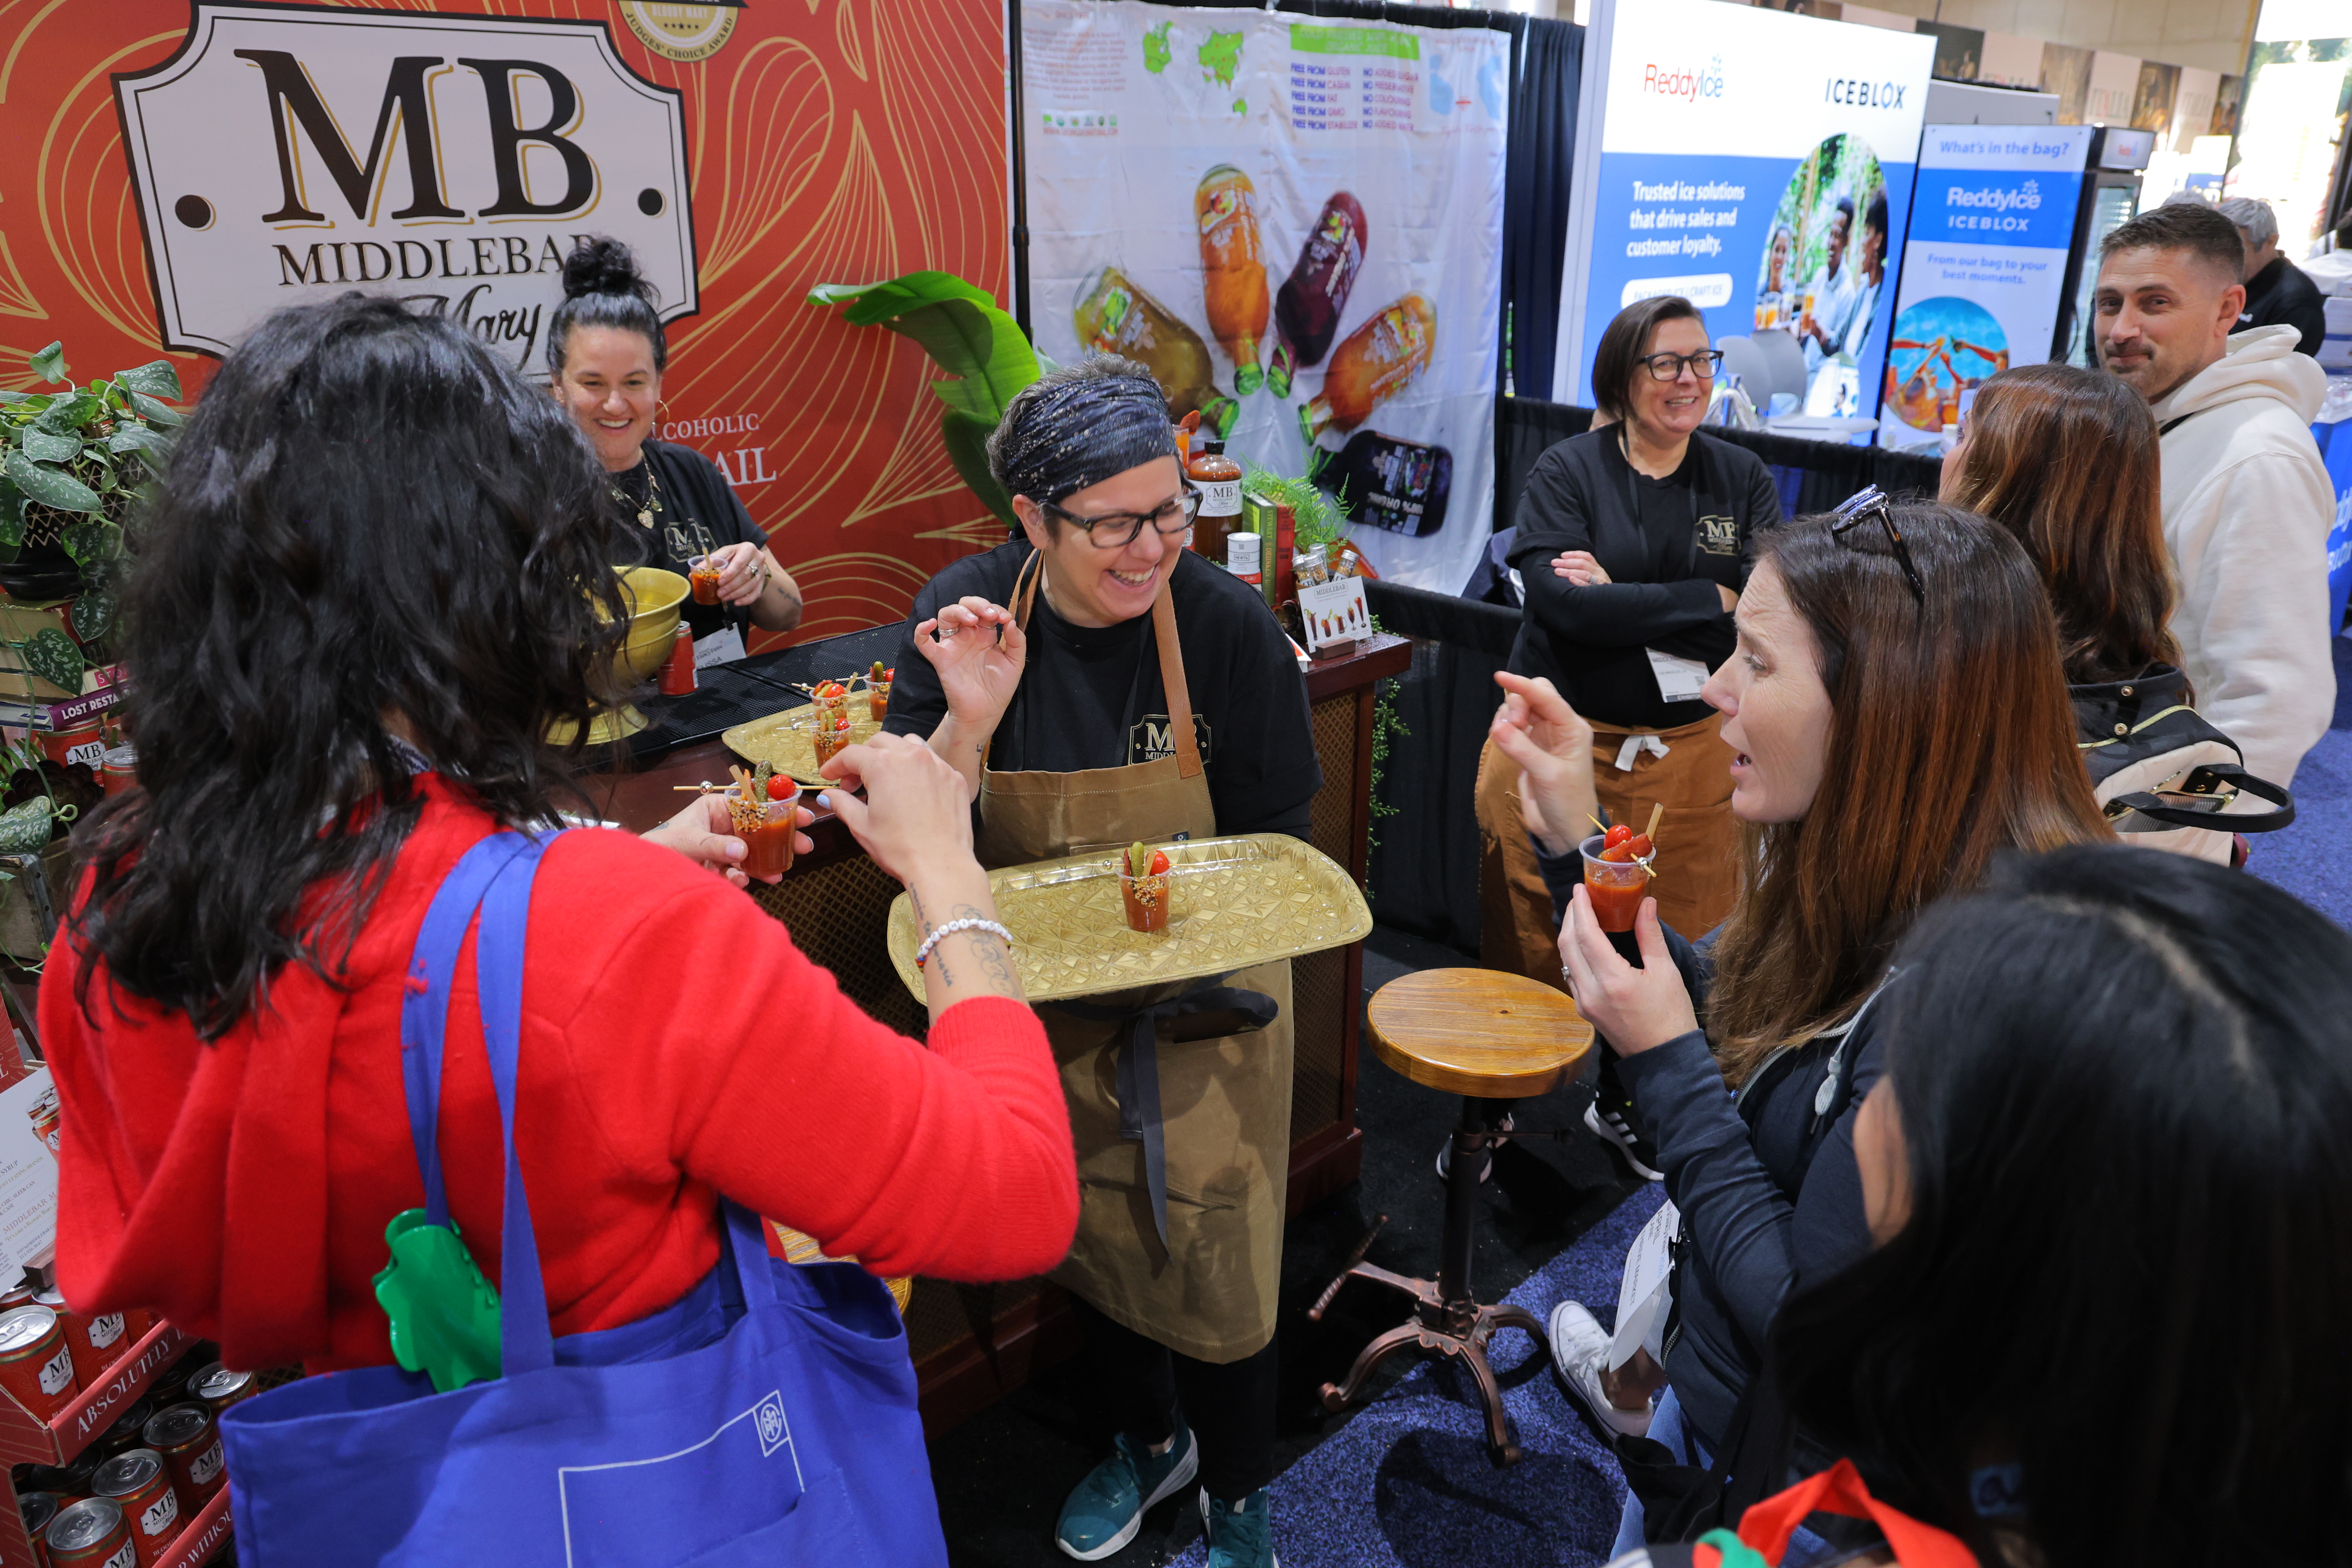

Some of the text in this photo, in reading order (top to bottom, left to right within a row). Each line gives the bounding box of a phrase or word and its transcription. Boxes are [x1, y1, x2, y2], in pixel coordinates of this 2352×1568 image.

[652, 4, 708, 19] BLOODY MARY
[667, 47, 706, 58] CHOICE
[708, 17, 732, 51] AWARD
[1291, 63, 1305, 73] FREE
[1307, 65, 1325, 75] FROM
[1363, 67, 1373, 76] NO
[1291, 77, 1305, 87] FREE
[1307, 79, 1325, 89] FROM
[1363, 81, 1372, 89] NO
[1644, 64, 1723, 102] ReddyIce
[1292, 90, 1305, 101] FREE
[1307, 92, 1326, 102] FROM
[1363, 95, 1373, 103] NO
[1825, 78, 1907, 109] ICEBLOX
[1292, 104, 1306, 114] FREE
[1308, 106, 1326, 116] FROM
[1363, 107, 1372, 116] NO
[1293, 118, 1306, 128] FREE
[1308, 120, 1326, 129] FROM
[1363, 120, 1372, 128] NO
[234, 48, 600, 227] MB
[1940, 140, 2069, 158] What's in the bag?
[1633, 180, 1746, 201] Trusted ice solutions
[1947, 186, 2042, 212] ReddyIce
[1630, 206, 1738, 230] that drive sales and
[1948, 215, 2030, 232] ICEBLOX
[1626, 233, 1722, 259] customer loyalty.
[1927, 253, 2048, 272] From our bag to your
[1942, 269, 2026, 285] best moments.
[652, 413, 760, 441] LCOHOLIC
[715, 447, 777, 487] AIL
[1213, 486, 1232, 498] MB
[1316, 584, 1347, 596] MIDDLEBAR
[61, 702, 87, 720] LOST
[73, 744, 101, 761] MB
[0, 1160, 18, 1176] SYRUP
[26, 1180, 35, 1189] CAN
[3, 1203, 14, 1213] CASE
[3, 1199, 48, 1234] MIDDLEBAR
[1653, 1210, 1663, 1245] APRIL
[1630, 1228, 1646, 1307] THRIVE MARKET
[78, 1334, 169, 1440] ABSOLUTELY
[149, 1491, 174, 1522] MB
